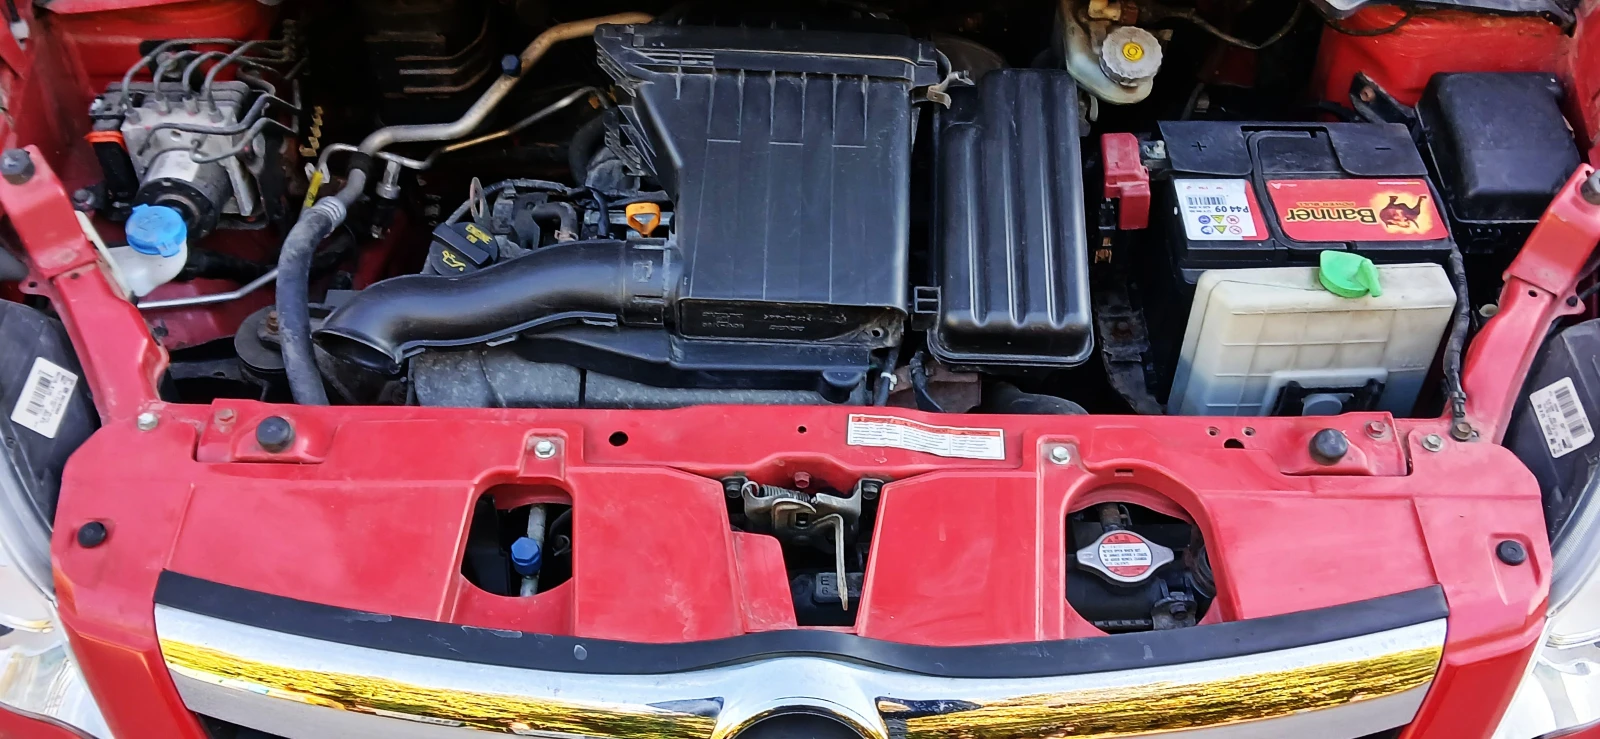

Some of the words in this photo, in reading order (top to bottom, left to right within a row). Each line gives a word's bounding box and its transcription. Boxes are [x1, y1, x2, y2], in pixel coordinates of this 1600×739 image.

[1215, 205, 1228, 213] 09
[1229, 205, 1249, 213] P44
[1286, 207, 1378, 224] Banner
